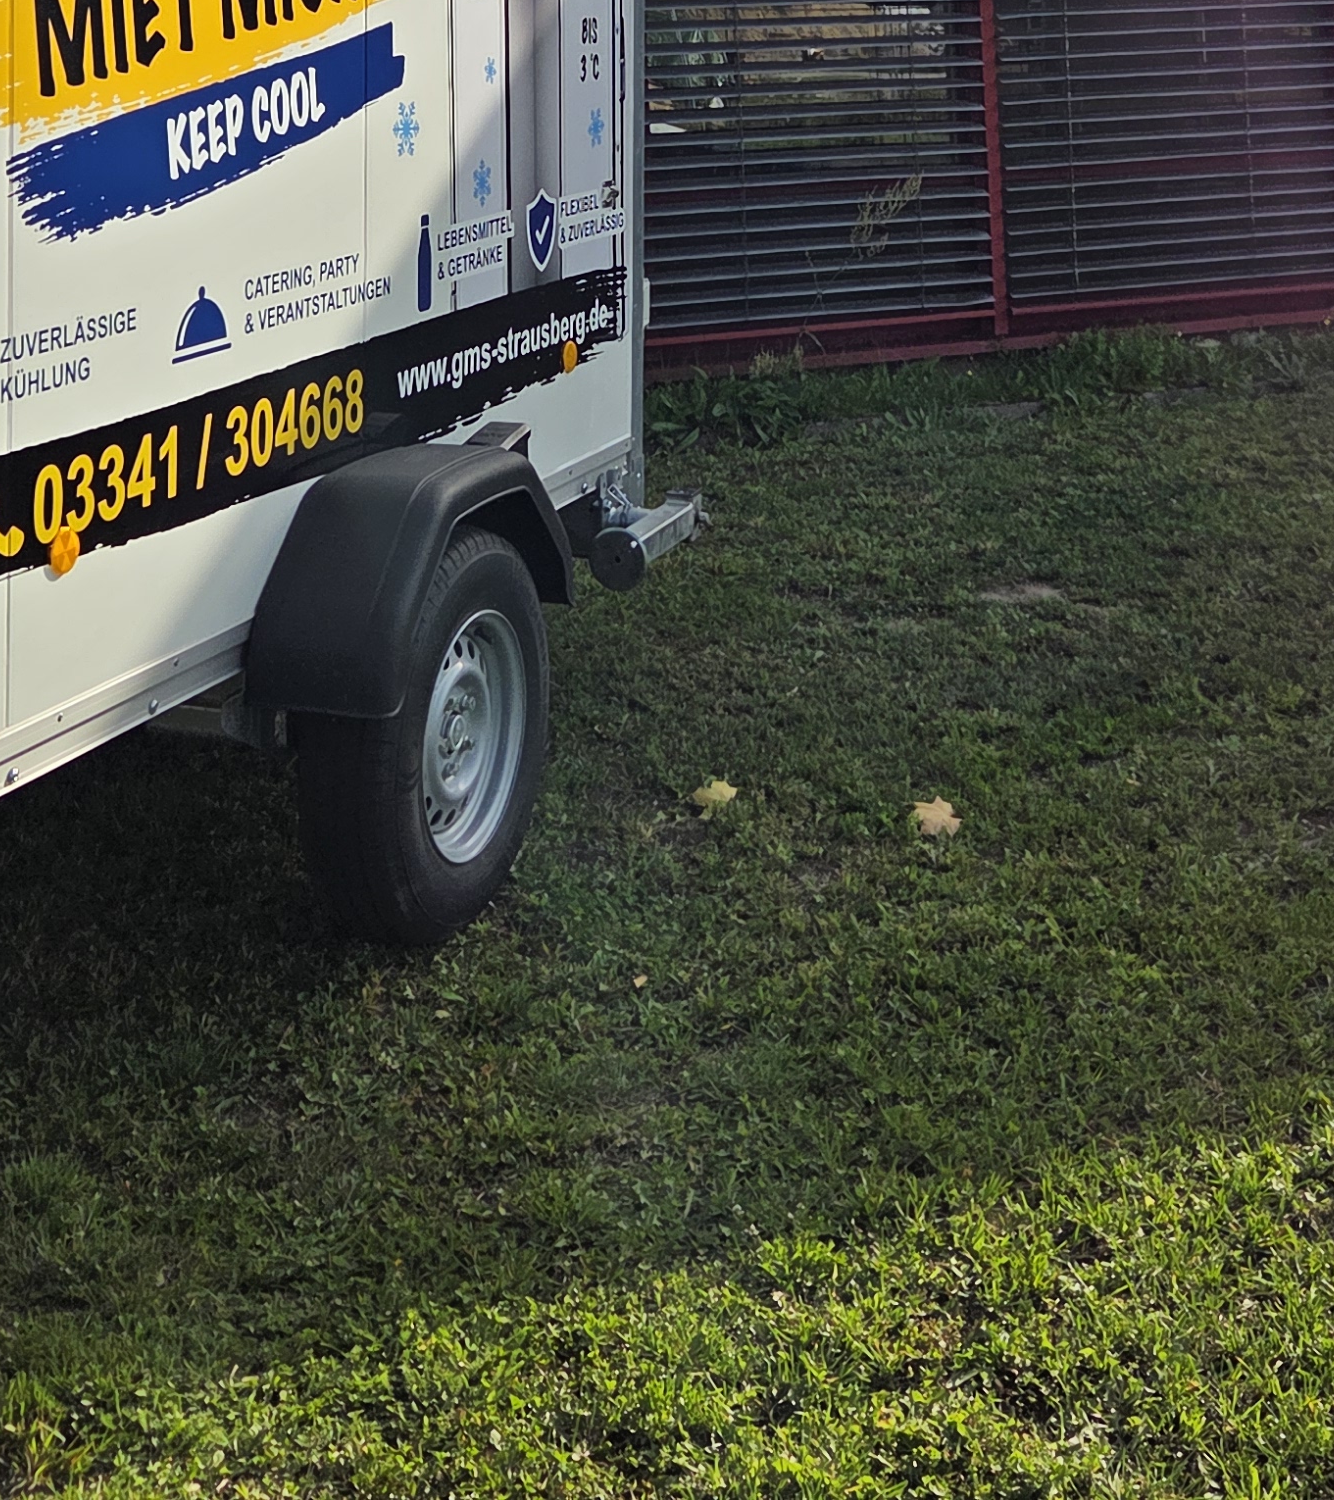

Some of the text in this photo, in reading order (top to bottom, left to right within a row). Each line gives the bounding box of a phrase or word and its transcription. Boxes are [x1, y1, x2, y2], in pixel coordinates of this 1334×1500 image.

[582, 17, 598, 44] BIS
[167, 67, 327, 181] KEEP COOL
[437, 215, 512, 251] LEBENSMITTEL
[244, 253, 359, 300] CATERING, PARTY
[438, 245, 503, 280] & GETRÄNKE
[244, 276, 391, 334] & VERANTSTALTUNGEN
[0, 308, 137, 364] ZUVERLÄSSIGE
[397, 298, 608, 398] www.gms-strausberg.de
[0, 357, 90, 404] KÜHLUNG
[33, 368, 364, 544] 03341 / 304668
